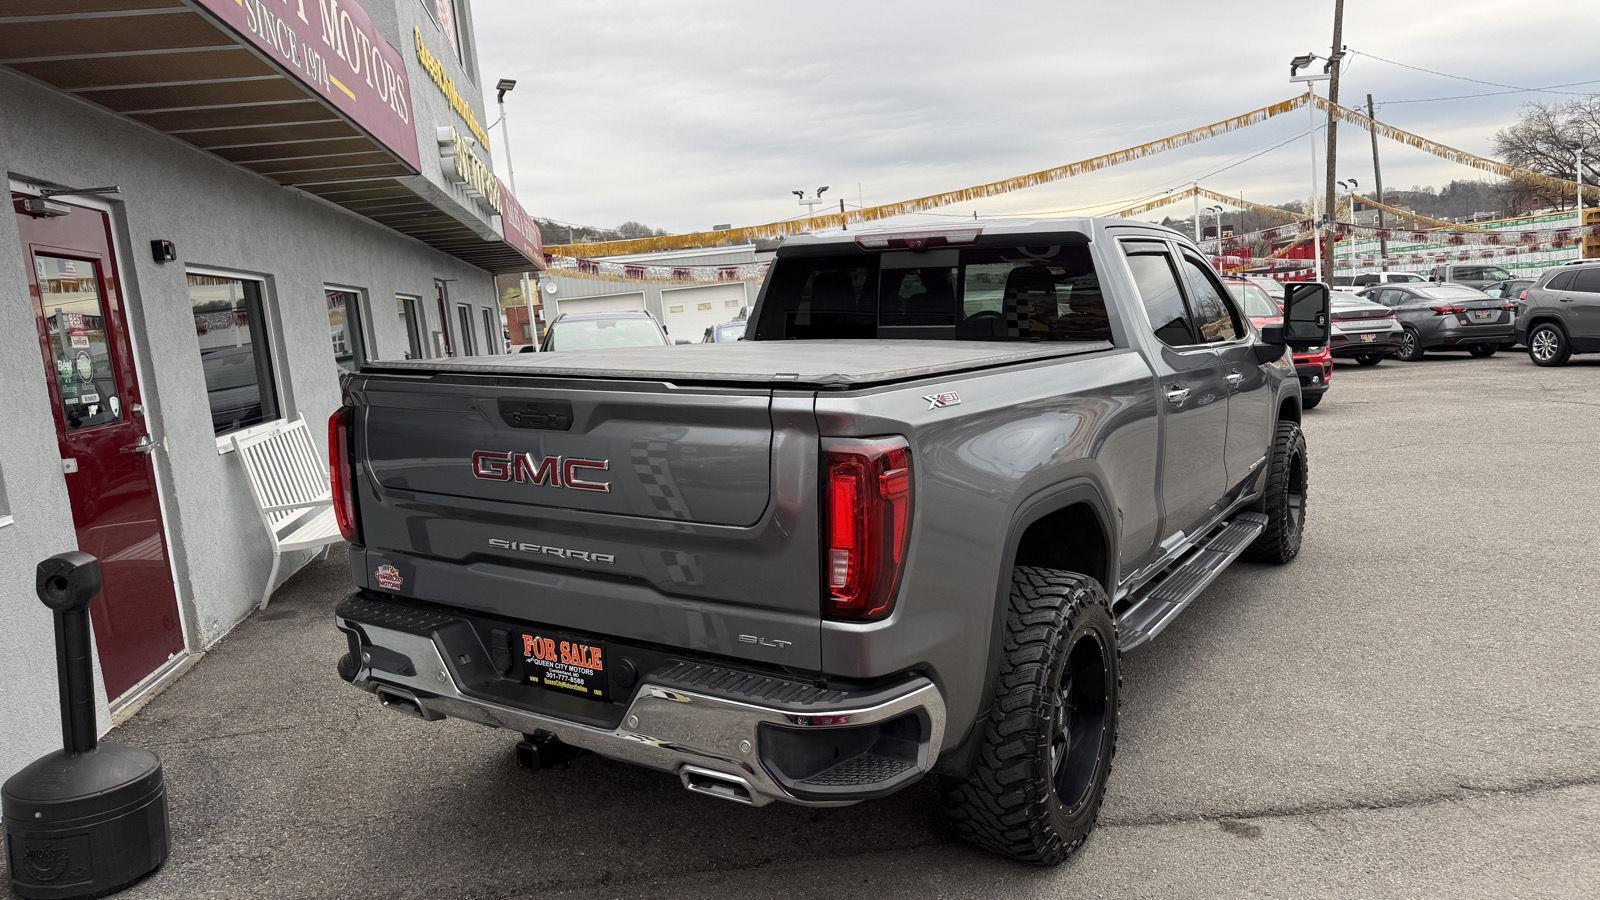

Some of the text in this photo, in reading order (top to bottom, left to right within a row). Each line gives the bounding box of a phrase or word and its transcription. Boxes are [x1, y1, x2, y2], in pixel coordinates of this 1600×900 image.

[244, 0, 301, 68] SINCE
[302, 43, 331, 95] 1974
[319, 0, 409, 125] MOTORS
[472, 450, 611, 493] GMC
[488, 538, 616, 565] SIERRA
[522, 634, 603, 670] FOR SALE
[738, 634, 792, 648] SLT
[533, 658, 594, 676] QUEEN CITY MOTORS
[545, 671, 585, 685] 301-777-8588
